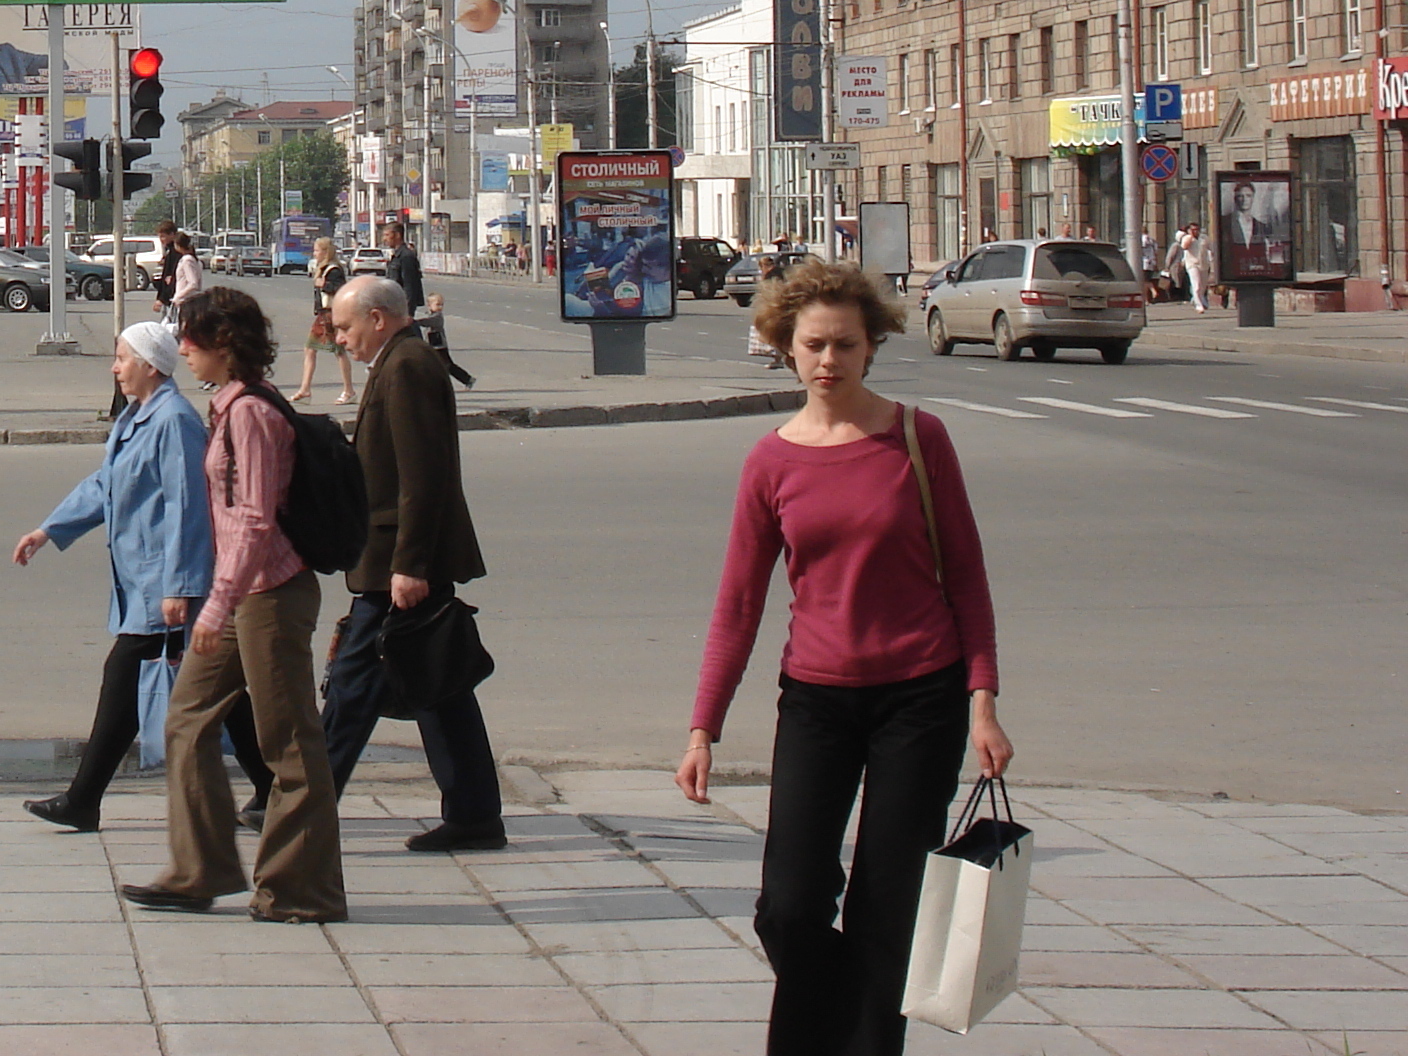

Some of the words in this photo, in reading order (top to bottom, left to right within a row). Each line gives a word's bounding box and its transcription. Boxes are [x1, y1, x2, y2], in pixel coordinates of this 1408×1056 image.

[23, 4, 132, 27] ГАЕРЕЯ
[849, 66, 877, 74] МЕСТО
[853, 78, 872, 86] ДЛЯ
[1270, 68, 1367, 106] КАФЕТЕРИЙ
[841, 90, 885, 98] РЕКЛАМЫ
[1155, 89, 1174, 117] P
[830, 152, 847, 160] УАЗ
[571, 160, 660, 177] СТОЛИЧНЫЙ
[579, 203, 600, 214] МОЙ
[601, 203, 640, 214] ЛИЧНЫЙ
[598, 216, 657, 227] СТОЛИЧНЫЙ!
